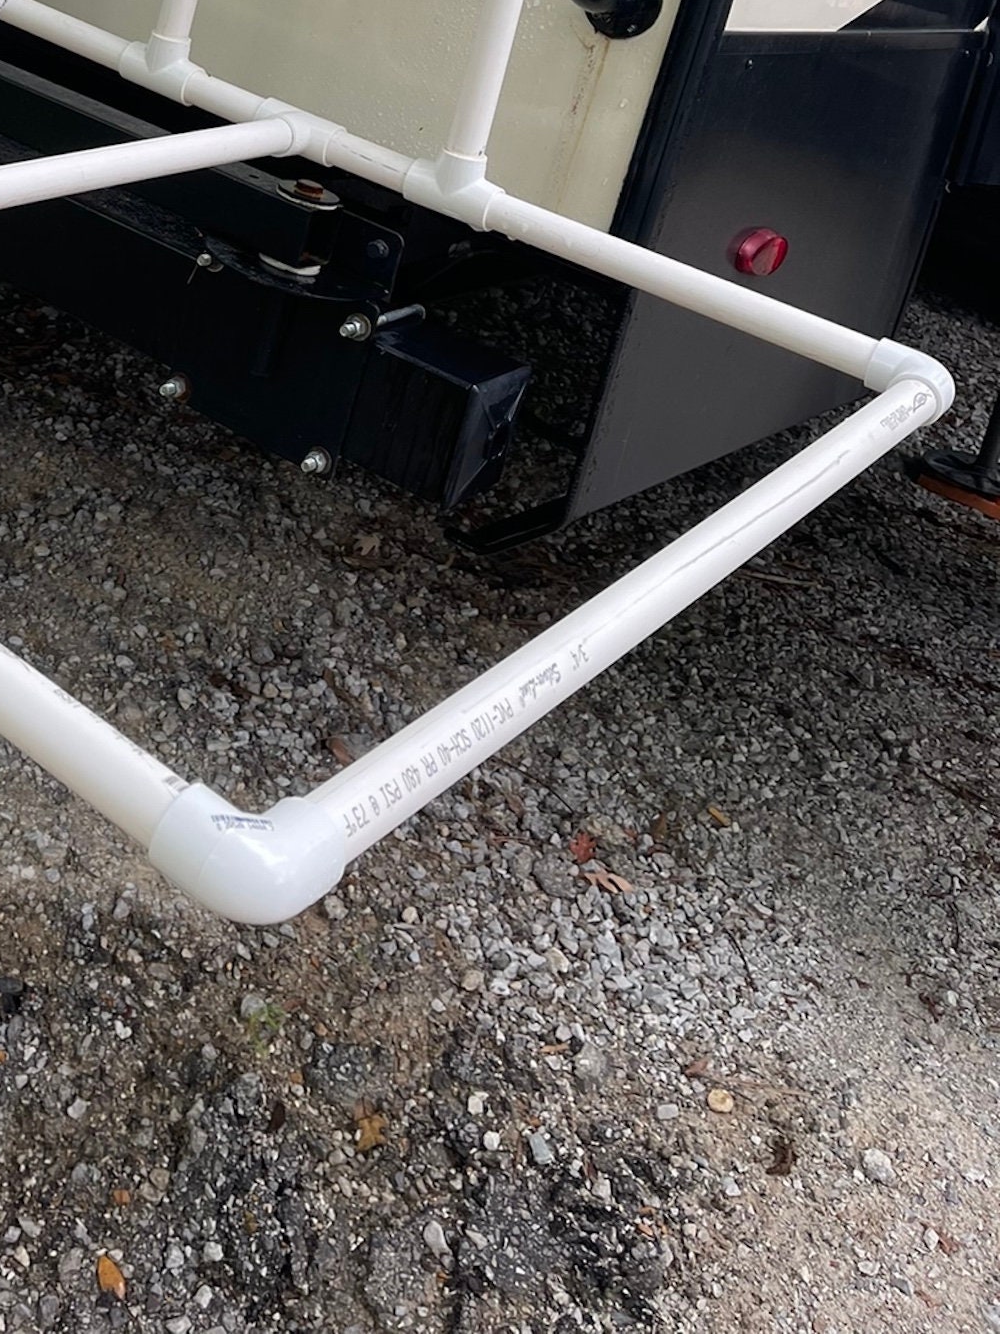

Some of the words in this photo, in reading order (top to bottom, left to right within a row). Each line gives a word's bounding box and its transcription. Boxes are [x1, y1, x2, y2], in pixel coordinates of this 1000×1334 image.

[569, 644, 590, 671] 3/4"
[473, 700, 516, 742] PVC-1120
[439, 732, 473, 766] SCH-40
[400, 765, 422, 792] 480
[423, 755, 440, 778] PR
[378, 780, 404, 808] PSI
[342, 808, 371, 837] 73°F
